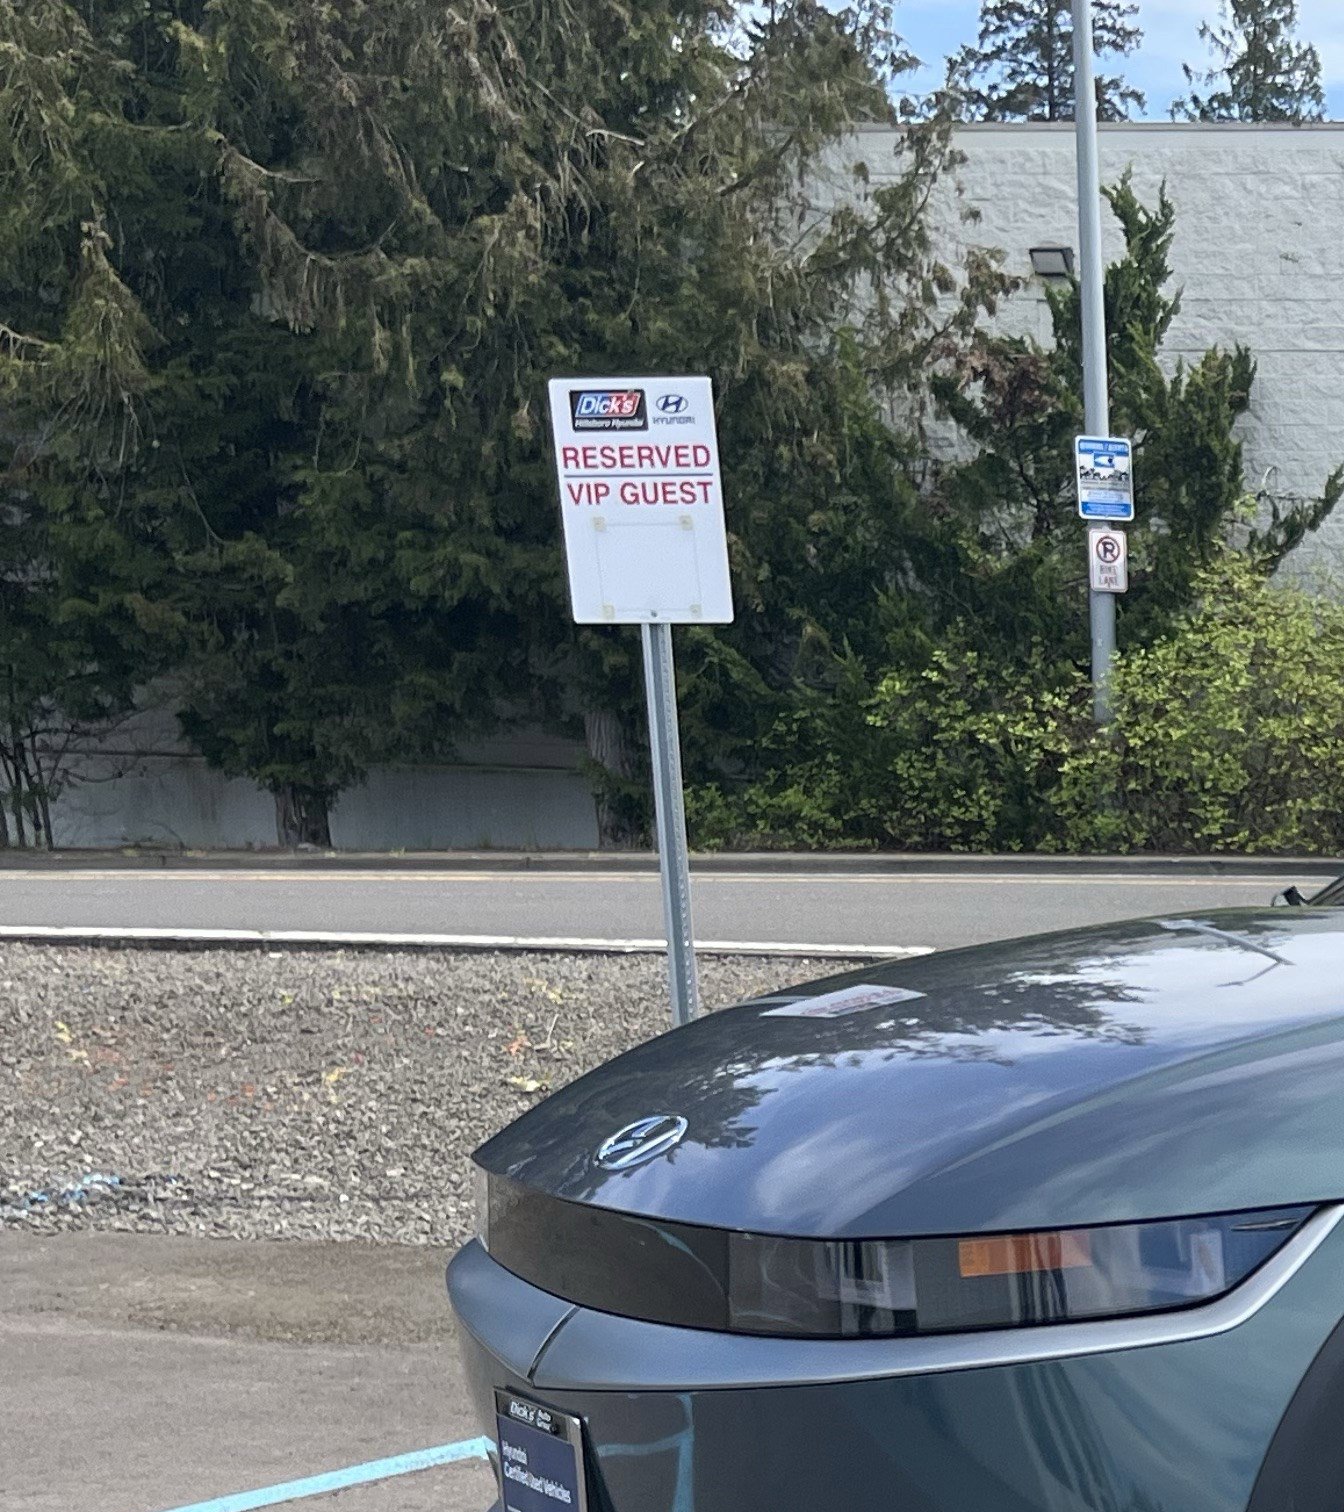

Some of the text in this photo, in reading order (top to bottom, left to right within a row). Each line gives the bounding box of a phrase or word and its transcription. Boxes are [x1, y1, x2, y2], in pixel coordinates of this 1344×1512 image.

[580, 394, 634, 414] Dick's
[562, 445, 711, 469] RESERVED
[567, 482, 713, 505] VIP GUEST
